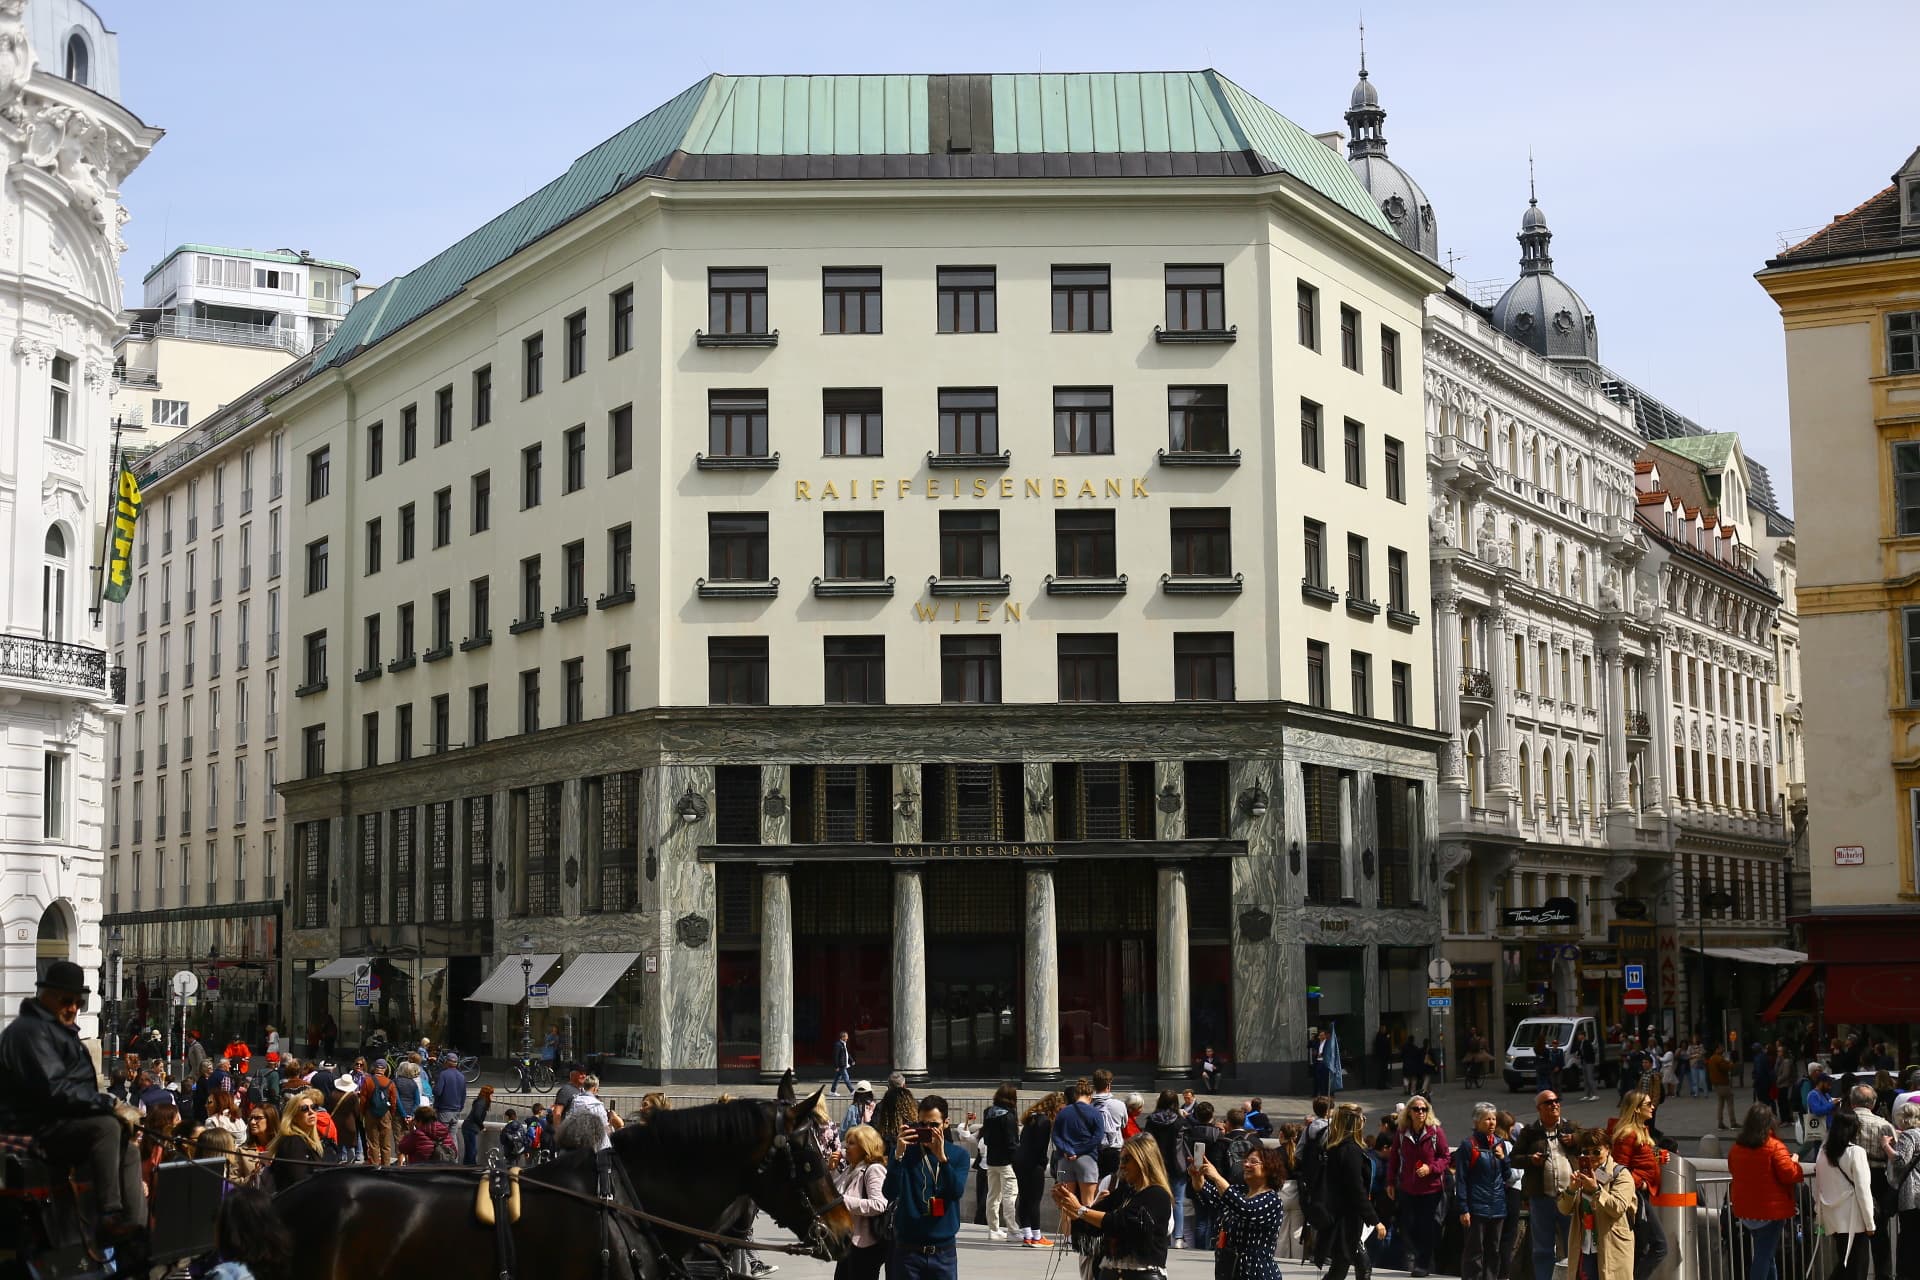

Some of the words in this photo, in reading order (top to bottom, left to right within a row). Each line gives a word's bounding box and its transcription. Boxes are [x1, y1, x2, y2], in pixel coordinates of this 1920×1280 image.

[795, 477, 1151, 501] RAIFFEISENBANK
[914, 600, 1024, 622] WIEN
[893, 845, 1056, 858] RAIFFEISENBANK
[1660, 936, 1676, 1005] MANZ
